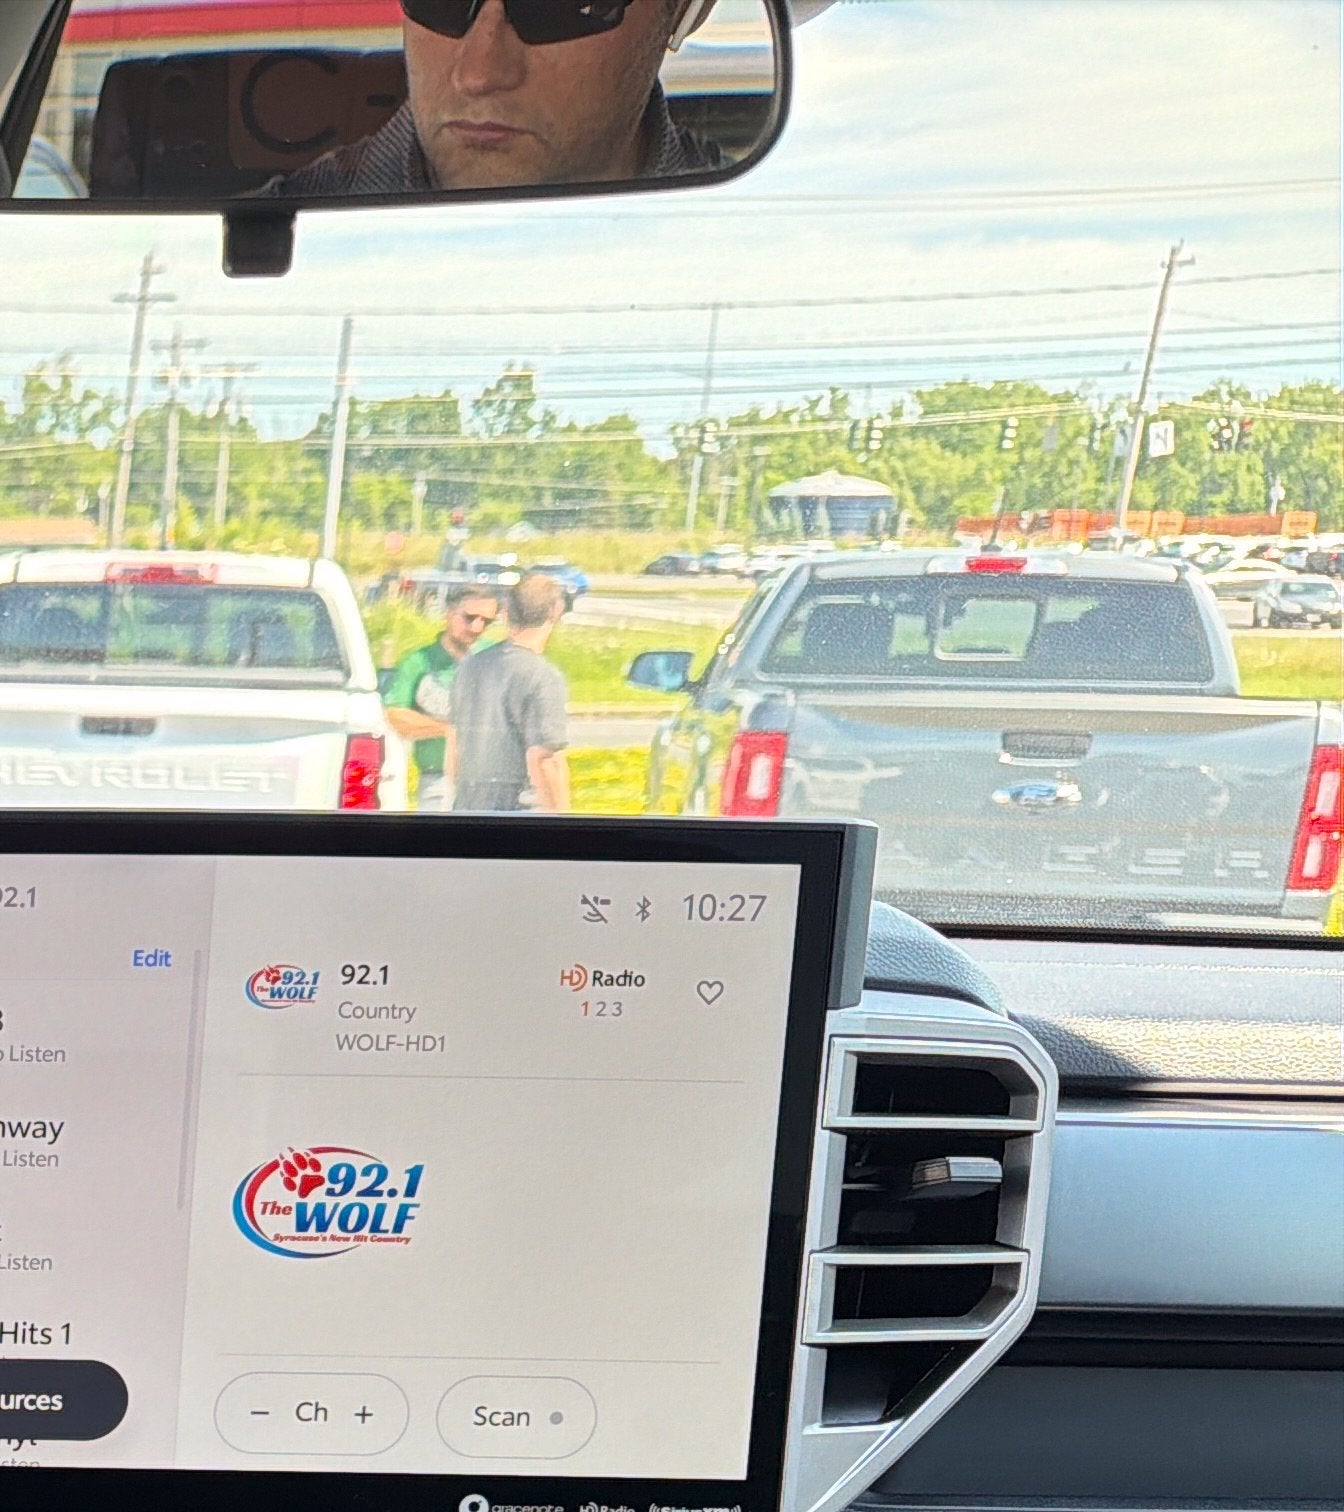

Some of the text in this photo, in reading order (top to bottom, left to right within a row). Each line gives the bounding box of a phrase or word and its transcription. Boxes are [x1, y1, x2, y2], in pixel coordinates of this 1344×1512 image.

[683, 894, 767, 921] 10:27
[132, 949, 172, 967] Edit
[281, 971, 320, 985] 92.1
[341, 965, 389, 985] 92.1
[592, 969, 645, 987] Radio
[269, 987, 318, 999] WOLF
[338, 1002, 416, 1023] Country
[581, 1001, 622, 1016] 1 2 3
[336, 1034, 446, 1052] WOLF-HD1
[9, 1045, 66, 1063] Listen
[3, 1150, 59, 1167] Listen
[325, 1163, 424, 1198] 92.1
[260, 1201, 421, 1234] The WOLF
[329, 1233, 351, 1242] New
[370, 1235, 412, 1245] Country
[61, 1322, 71, 1344] 1
[296, 1401, 328, 1421] Ch
[473, 1405, 530, 1427] Scan
